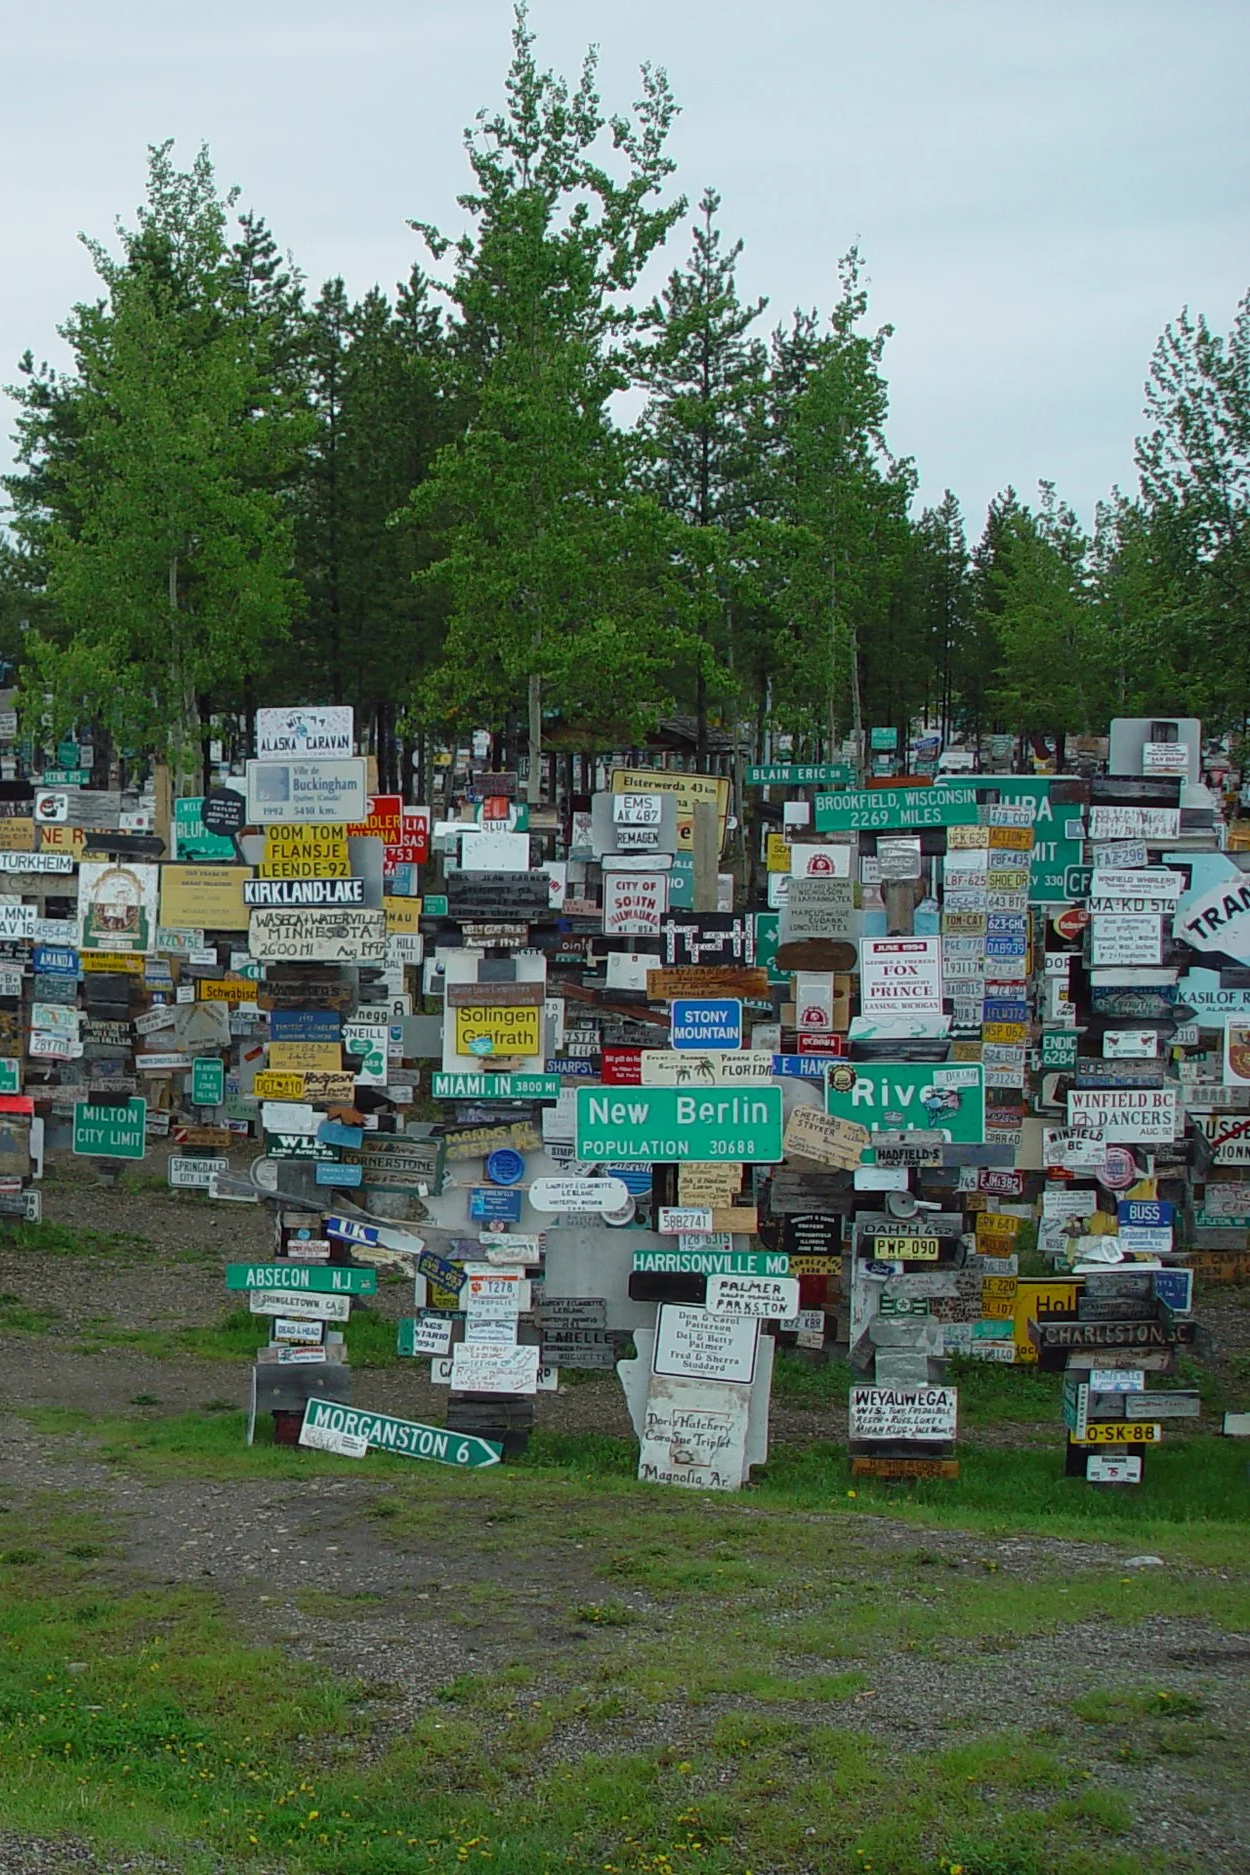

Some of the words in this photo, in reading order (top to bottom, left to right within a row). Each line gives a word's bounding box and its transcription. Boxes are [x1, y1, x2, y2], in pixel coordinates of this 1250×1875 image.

[260, 735, 297, 752] ALASKA
[306, 734, 350, 751] CARAVAN
[752, 769, 790, 780] BLAIN
[797, 769, 826, 780] ERIC
[293, 778, 357, 795] Buckingham
[623, 776, 686, 792] Elsterwerda
[689, 784, 703, 793] 43
[623, 796, 653, 810] EMS
[816, 793, 900, 811] BROOKFIELD,
[905, 789, 976, 807] WISCONSIN
[263, 807, 284, 816] 1992
[616, 811, 633, 822] AK
[635, 810, 658, 823] 487
[850, 812, 889, 827] 2269
[900, 808, 942, 823] MILES
[269, 826, 303, 840] OOM
[311, 826, 344, 840] TOM
[617, 832, 659, 845] REMAGEN
[271, 844, 340, 859] FLANSJE
[261, 862, 347, 878] LEENDE-92
[615, 881, 639, 892] CITY
[641, 881, 657, 891] OF
[1044, 875, 1063, 887] 330
[244, 881, 363, 903] KIRKLAND-LAKE
[4, 906, 27, 920] MN
[1150, 897, 1175, 913] 514
[21, 920, 34, 935] 16
[267, 924, 374, 940] MINNESOTA
[259, 942, 297, 956] 2600
[336, 943, 357, 958] Aug
[39, 951, 75, 967] AMANDA
[883, 964, 919, 976] FOX
[870, 985, 934, 998] PRINCE
[1177, 991, 1237, 1005] KASILOF
[459, 1007, 537, 1026] Solingen
[684, 1010, 729, 1024] STONY
[461, 1029, 535, 1046] Gräfrath
[674, 1026, 740, 1041] MOUNTAIN
[1043, 1050, 1075, 1065] 6284
[493, 1076, 511, 1095] IN
[515, 1081, 542, 1092] 3800
[545, 1081, 556, 1092] MI
[1072, 1093, 1147, 1108] WINFIELD
[1151, 1093, 1173, 1107] BC
[82, 1106, 138, 1125] MILTON
[588, 1096, 650, 1126] New
[676, 1096, 768, 1126] Berlin
[1098, 1110, 1172, 1126] DANCERS
[76, 1126, 104, 1144] CITY
[110, 1129, 141, 1149] LIMIT
[1048, 1128, 1104, 1144] WINFIELD
[1139, 1128, 1157, 1137] AUG
[582, 1140, 690, 1156] POPULATION
[709, 1140, 756, 1155] 30688
[1067, 1140, 1084, 1151] BC
[173, 1159, 223, 1173] SPRINGDALE
[344, 1155, 434, 1172] CORNERSTONE
[1129, 1204, 1161, 1221] BUSS
[924, 1226, 953, 1236] 452
[633, 1253, 758, 1273] HARRISONVILLE
[765, 1254, 790, 1273] MO
[245, 1268, 309, 1288] ABSECON
[487, 1280, 513, 1293] T278
[719, 1280, 782, 1295] PALMER
[716, 1298, 789, 1314] PARKSTON
[686, 1340, 724, 1352] Palmer
[647, 1412, 678, 1428] Doris
[314, 1404, 449, 1460] MORGANSTON
[456, 1444, 471, 1463] 6
[672, 1431, 691, 1446] Sue
